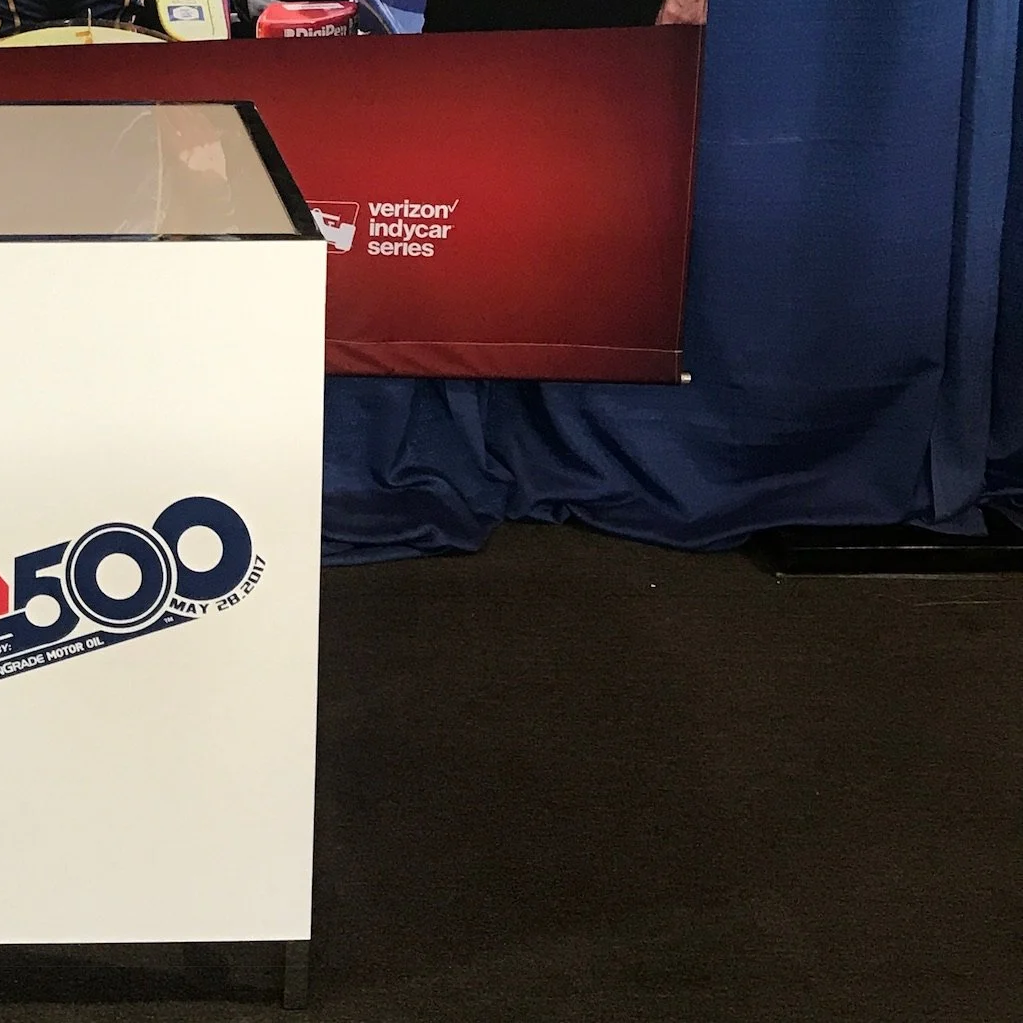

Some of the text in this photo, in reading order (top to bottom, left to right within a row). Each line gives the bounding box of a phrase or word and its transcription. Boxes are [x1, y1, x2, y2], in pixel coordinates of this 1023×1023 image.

[368, 199, 449, 219] verizon
[369, 218, 452, 241] indycar
[367, 240, 435, 257] series
[13, 495, 253, 643] 500
[169, 597, 210, 615] MAY
[47, 642, 85, 662] MOTOR
[86, 636, 105, 649] OIL
